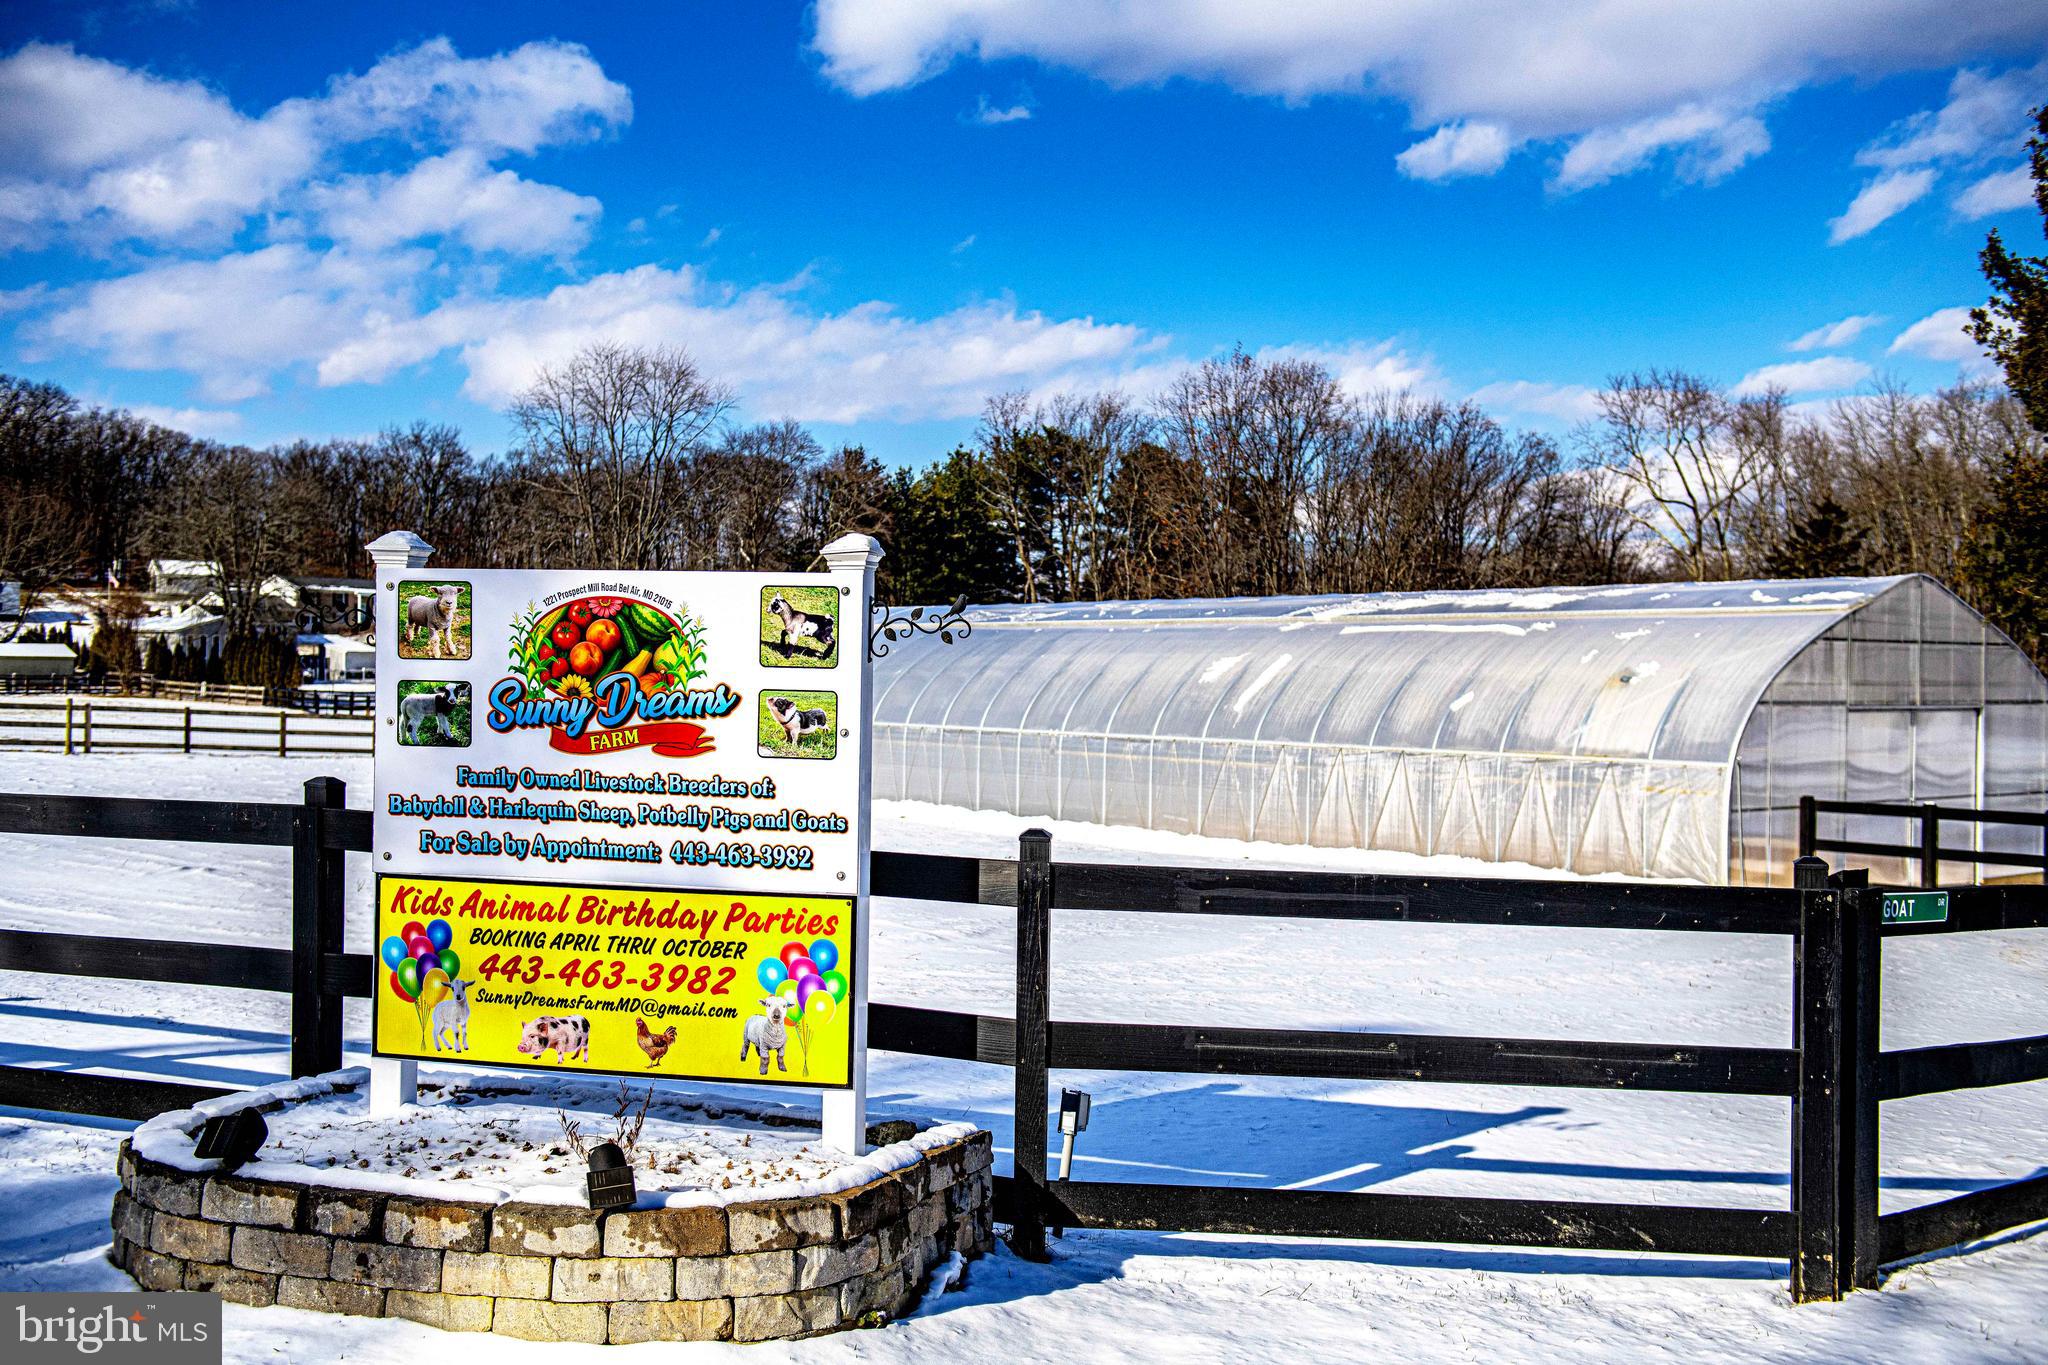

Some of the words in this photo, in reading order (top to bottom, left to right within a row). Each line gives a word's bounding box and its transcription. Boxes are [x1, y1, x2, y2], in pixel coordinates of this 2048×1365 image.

[543, 594, 558, 606] 1221
[557, 585, 587, 600] Prospect
[587, 582, 600, 592] Mill
[600, 582, 618, 592] Road
[618, 584, 630, 593] Bel
[630, 586, 641, 597] Air,
[642, 589, 654, 600] MD
[488, 678, 596, 739] Sunny
[593, 671, 741, 729] Dreams
[589, 728, 640, 751] FARM
[457, 765, 517, 792] Family
[519, 768, 581, 790] Owned
[583, 770, 666, 794] Livestock
[668, 773, 747, 797] Breeders
[750, 777, 776, 799] of:
[388, 795, 467, 820] Babydoll
[469, 797, 486, 817] &
[488, 798, 576, 825] Harlequin
[578, 800, 635, 828] Sheep,
[637, 803, 710, 833] Potbelly
[711, 806, 750, 834] Pigs
[752, 808, 790, 832] and
[791, 811, 849, 834] Goats
[419, 830, 455, 853] For
[456, 830, 500, 856] Sale
[503, 832, 529, 861] by
[531, 833, 663, 864] Appointment:
[669, 840, 814, 870] 443-463-3982
[390, 885, 454, 917] Kids
[458, 889, 571, 924] Animal
[575, 895, 718, 940] Birthday
[722, 902, 839, 936] Parties
[1883, 900, 1915, 918] GOAT
[1938, 898, 1946, 906] DR
[469, 927, 547, 951] BOOKING
[549, 932, 601, 952] APRIL
[607, 935, 658, 955] THRU
[662, 938, 748, 960] OCTOBER
[478, 953, 737, 996] 443-463-3982
[475, 988, 739, 1019] SunnyDreamsFarmMD@gmail.com
